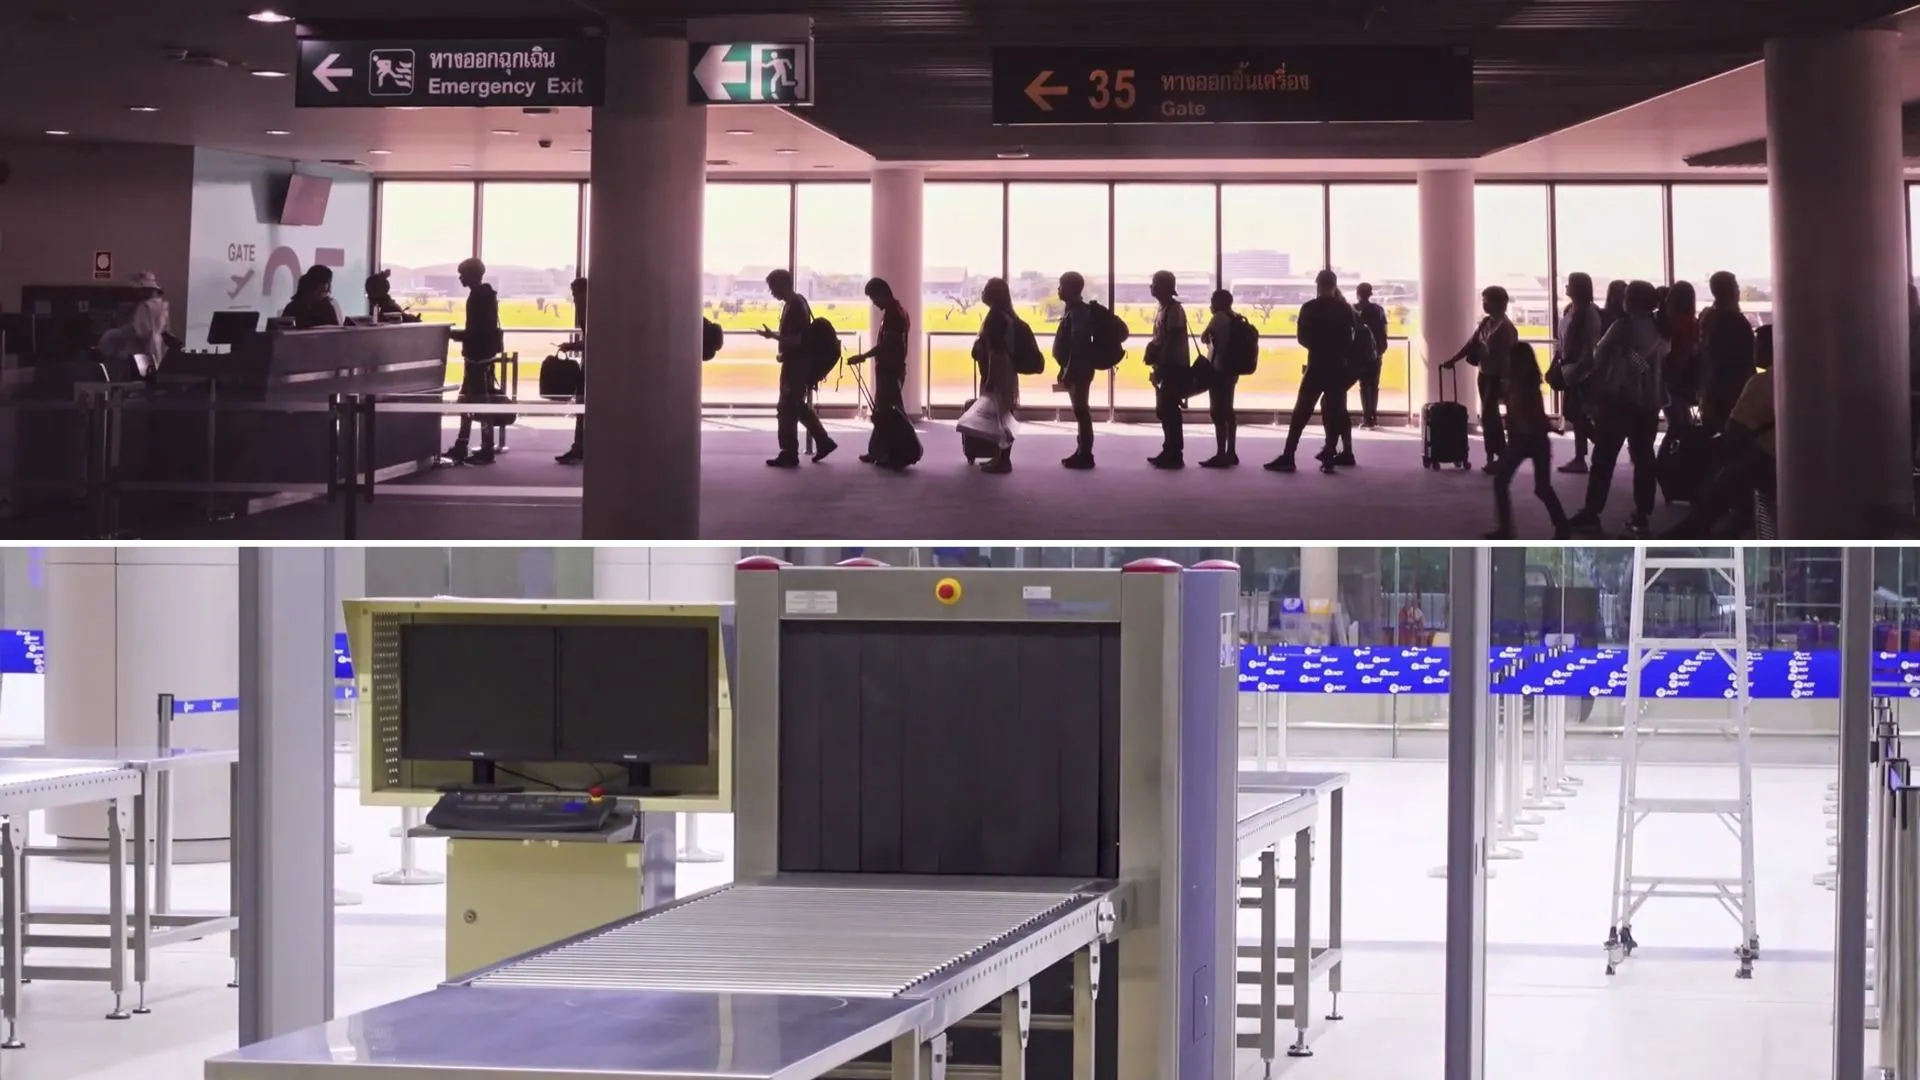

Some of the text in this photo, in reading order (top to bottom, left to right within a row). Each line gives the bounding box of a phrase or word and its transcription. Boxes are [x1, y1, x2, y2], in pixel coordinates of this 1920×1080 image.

[429, 46, 556, 75] ทางออกฉุกเฉิน
[428, 77, 584, 98] Emergency Exit
[1161, 61, 1310, 91] ทางออกขึ้นเครื่อง
[1088, 69, 1136, 109] 35
[1161, 100, 1206, 116] Gate
[228, 243, 256, 262] GATE
